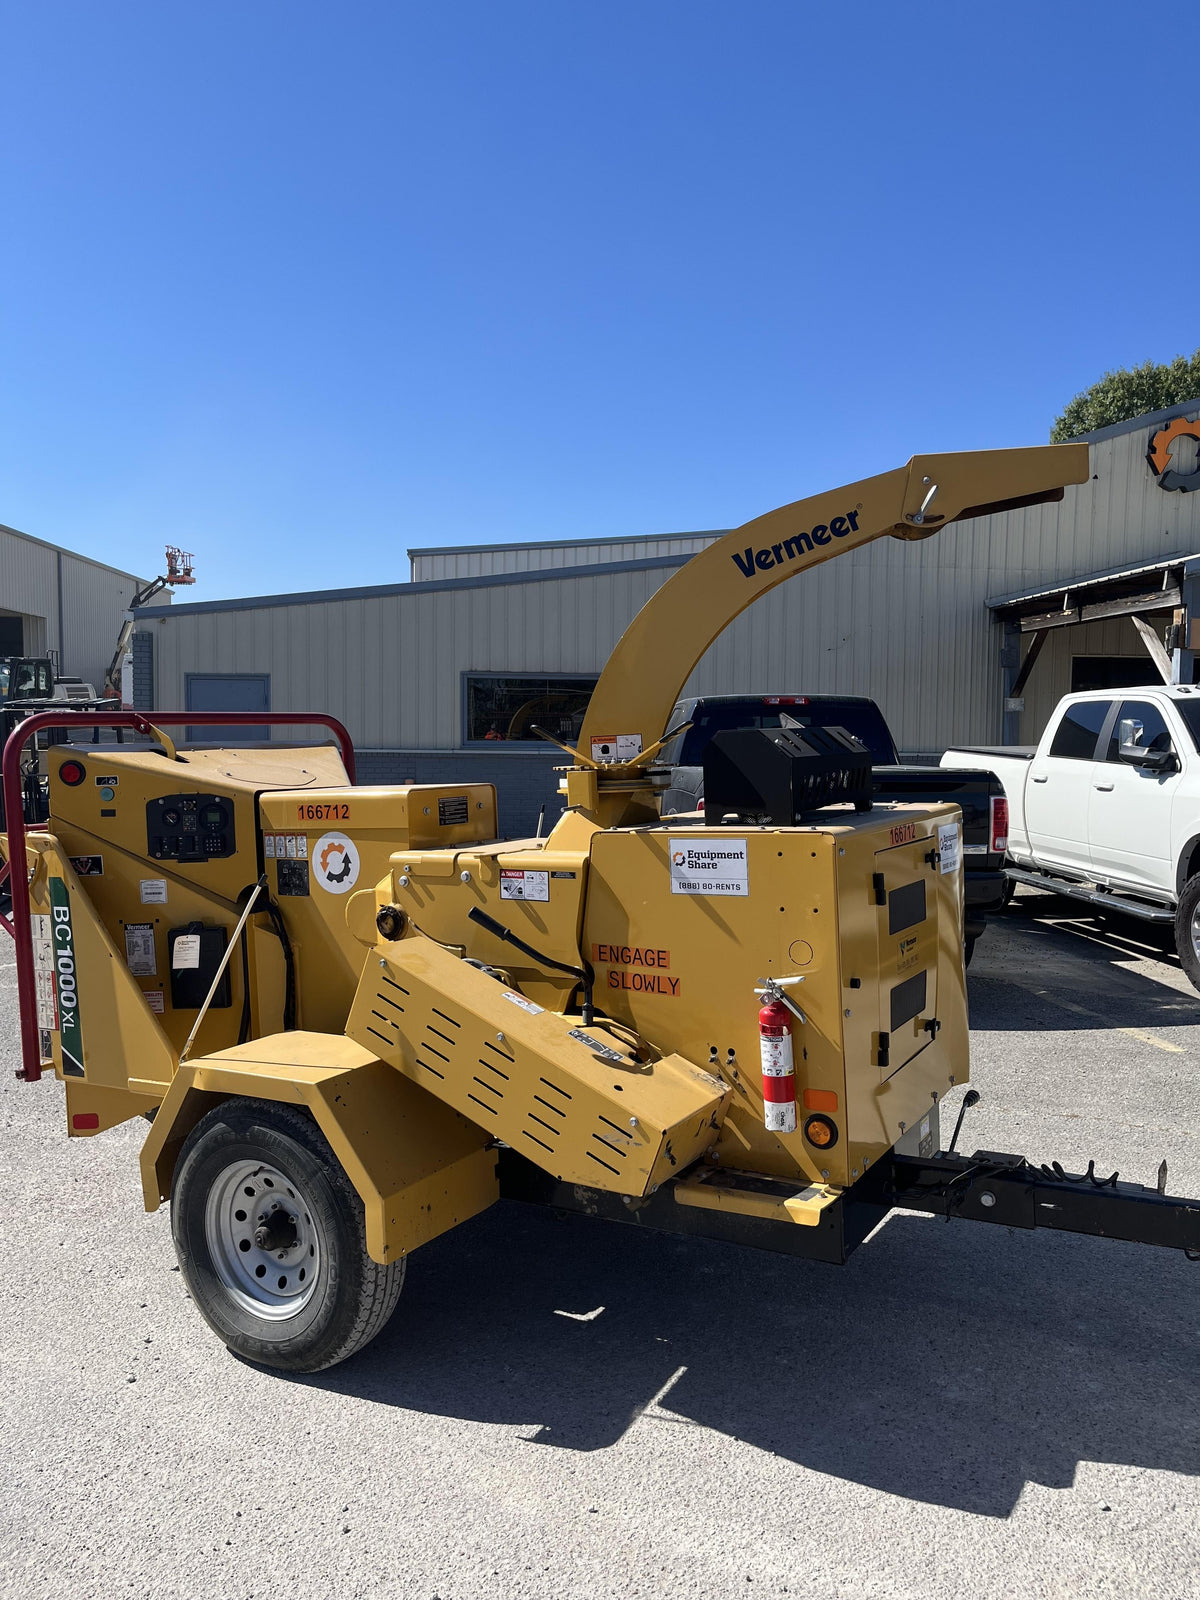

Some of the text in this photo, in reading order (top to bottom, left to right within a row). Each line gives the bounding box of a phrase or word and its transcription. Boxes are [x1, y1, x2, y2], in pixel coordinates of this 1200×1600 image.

[731, 509, 859, 578] Vermeer
[298, 804, 350, 819] 166712
[889, 823, 916, 845] 166712
[687, 850, 744, 860] Equipment
[687, 860, 718, 869] Share
[678, 881, 741, 891] (888) 80-RENTS
[598, 944, 668, 968] ENGAGE
[53, 906, 78, 1034] BC 1000 XL
[609, 970, 680, 995] SLOWLY
